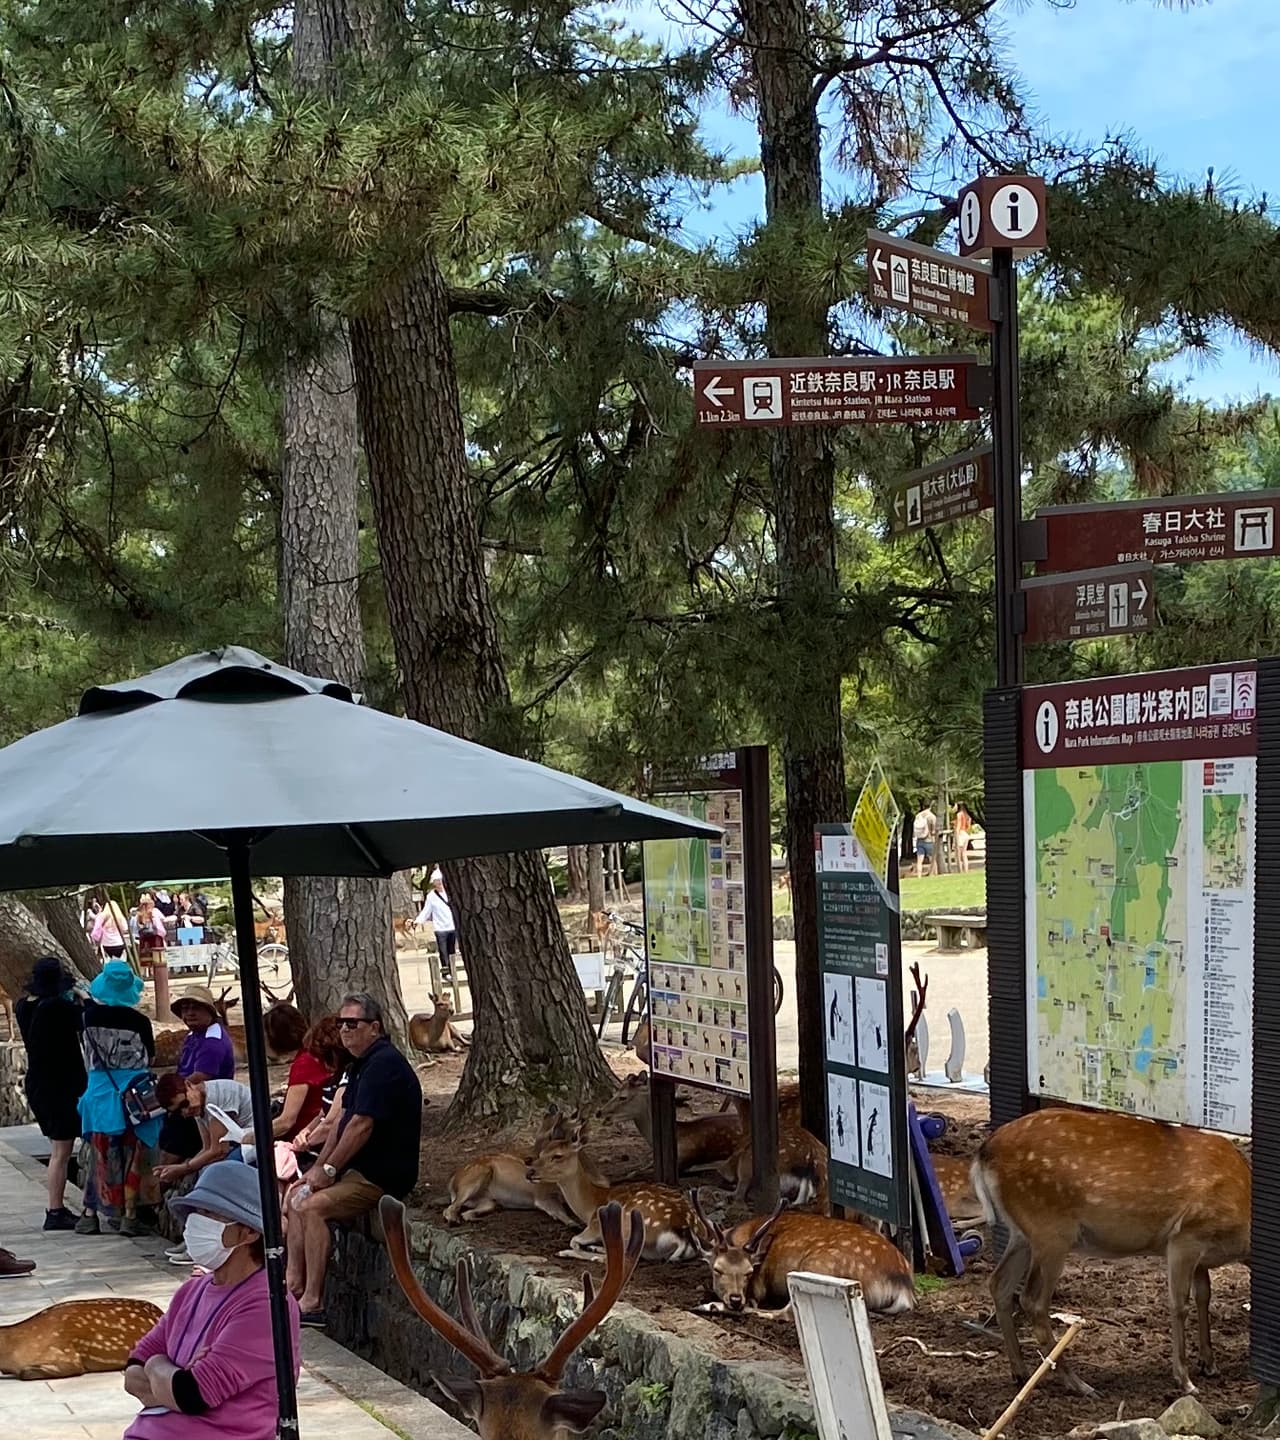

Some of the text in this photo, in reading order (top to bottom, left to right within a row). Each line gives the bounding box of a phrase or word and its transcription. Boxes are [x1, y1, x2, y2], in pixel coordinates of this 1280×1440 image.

[911, 258, 975, 296] 奈良国立博物館
[791, 397, 821, 407] Kintetsu
[823, 397, 841, 406] Nara
[874, 395, 883, 405] JR
[885, 394, 902, 404] Nara
[904, 393, 931, 403] Station
[699, 410, 740, 422] 1.1km 2.3km
[1142, 507, 1225, 534] 春日大社
[1145, 533, 1226, 547] Kasuga Taisha Shrine
[1065, 685, 1208, 730] 奈良公園観光案内図
[1064, 732, 1133, 748] Nara Park Information Map
